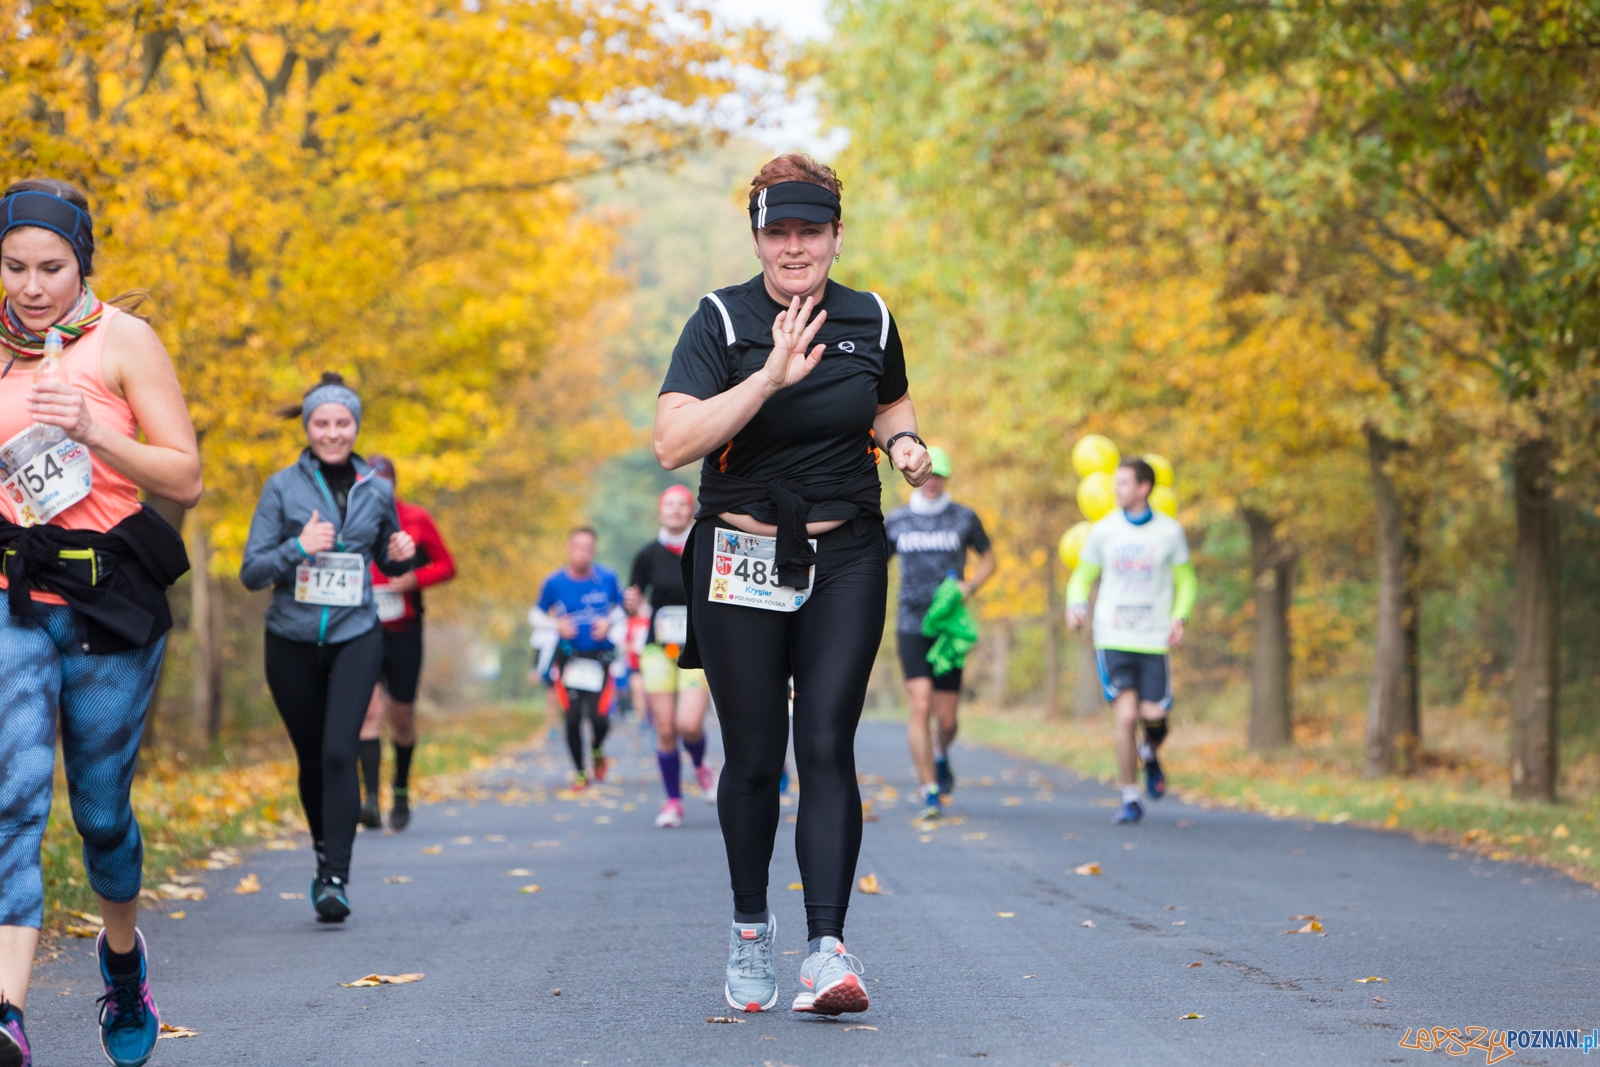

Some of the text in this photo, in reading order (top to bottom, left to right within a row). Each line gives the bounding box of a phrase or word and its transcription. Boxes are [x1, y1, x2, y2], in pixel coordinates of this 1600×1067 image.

[17, 453, 64, 500] 154
[313, 570, 346, 588] 174
[764, 599, 787, 608] POLSKA
